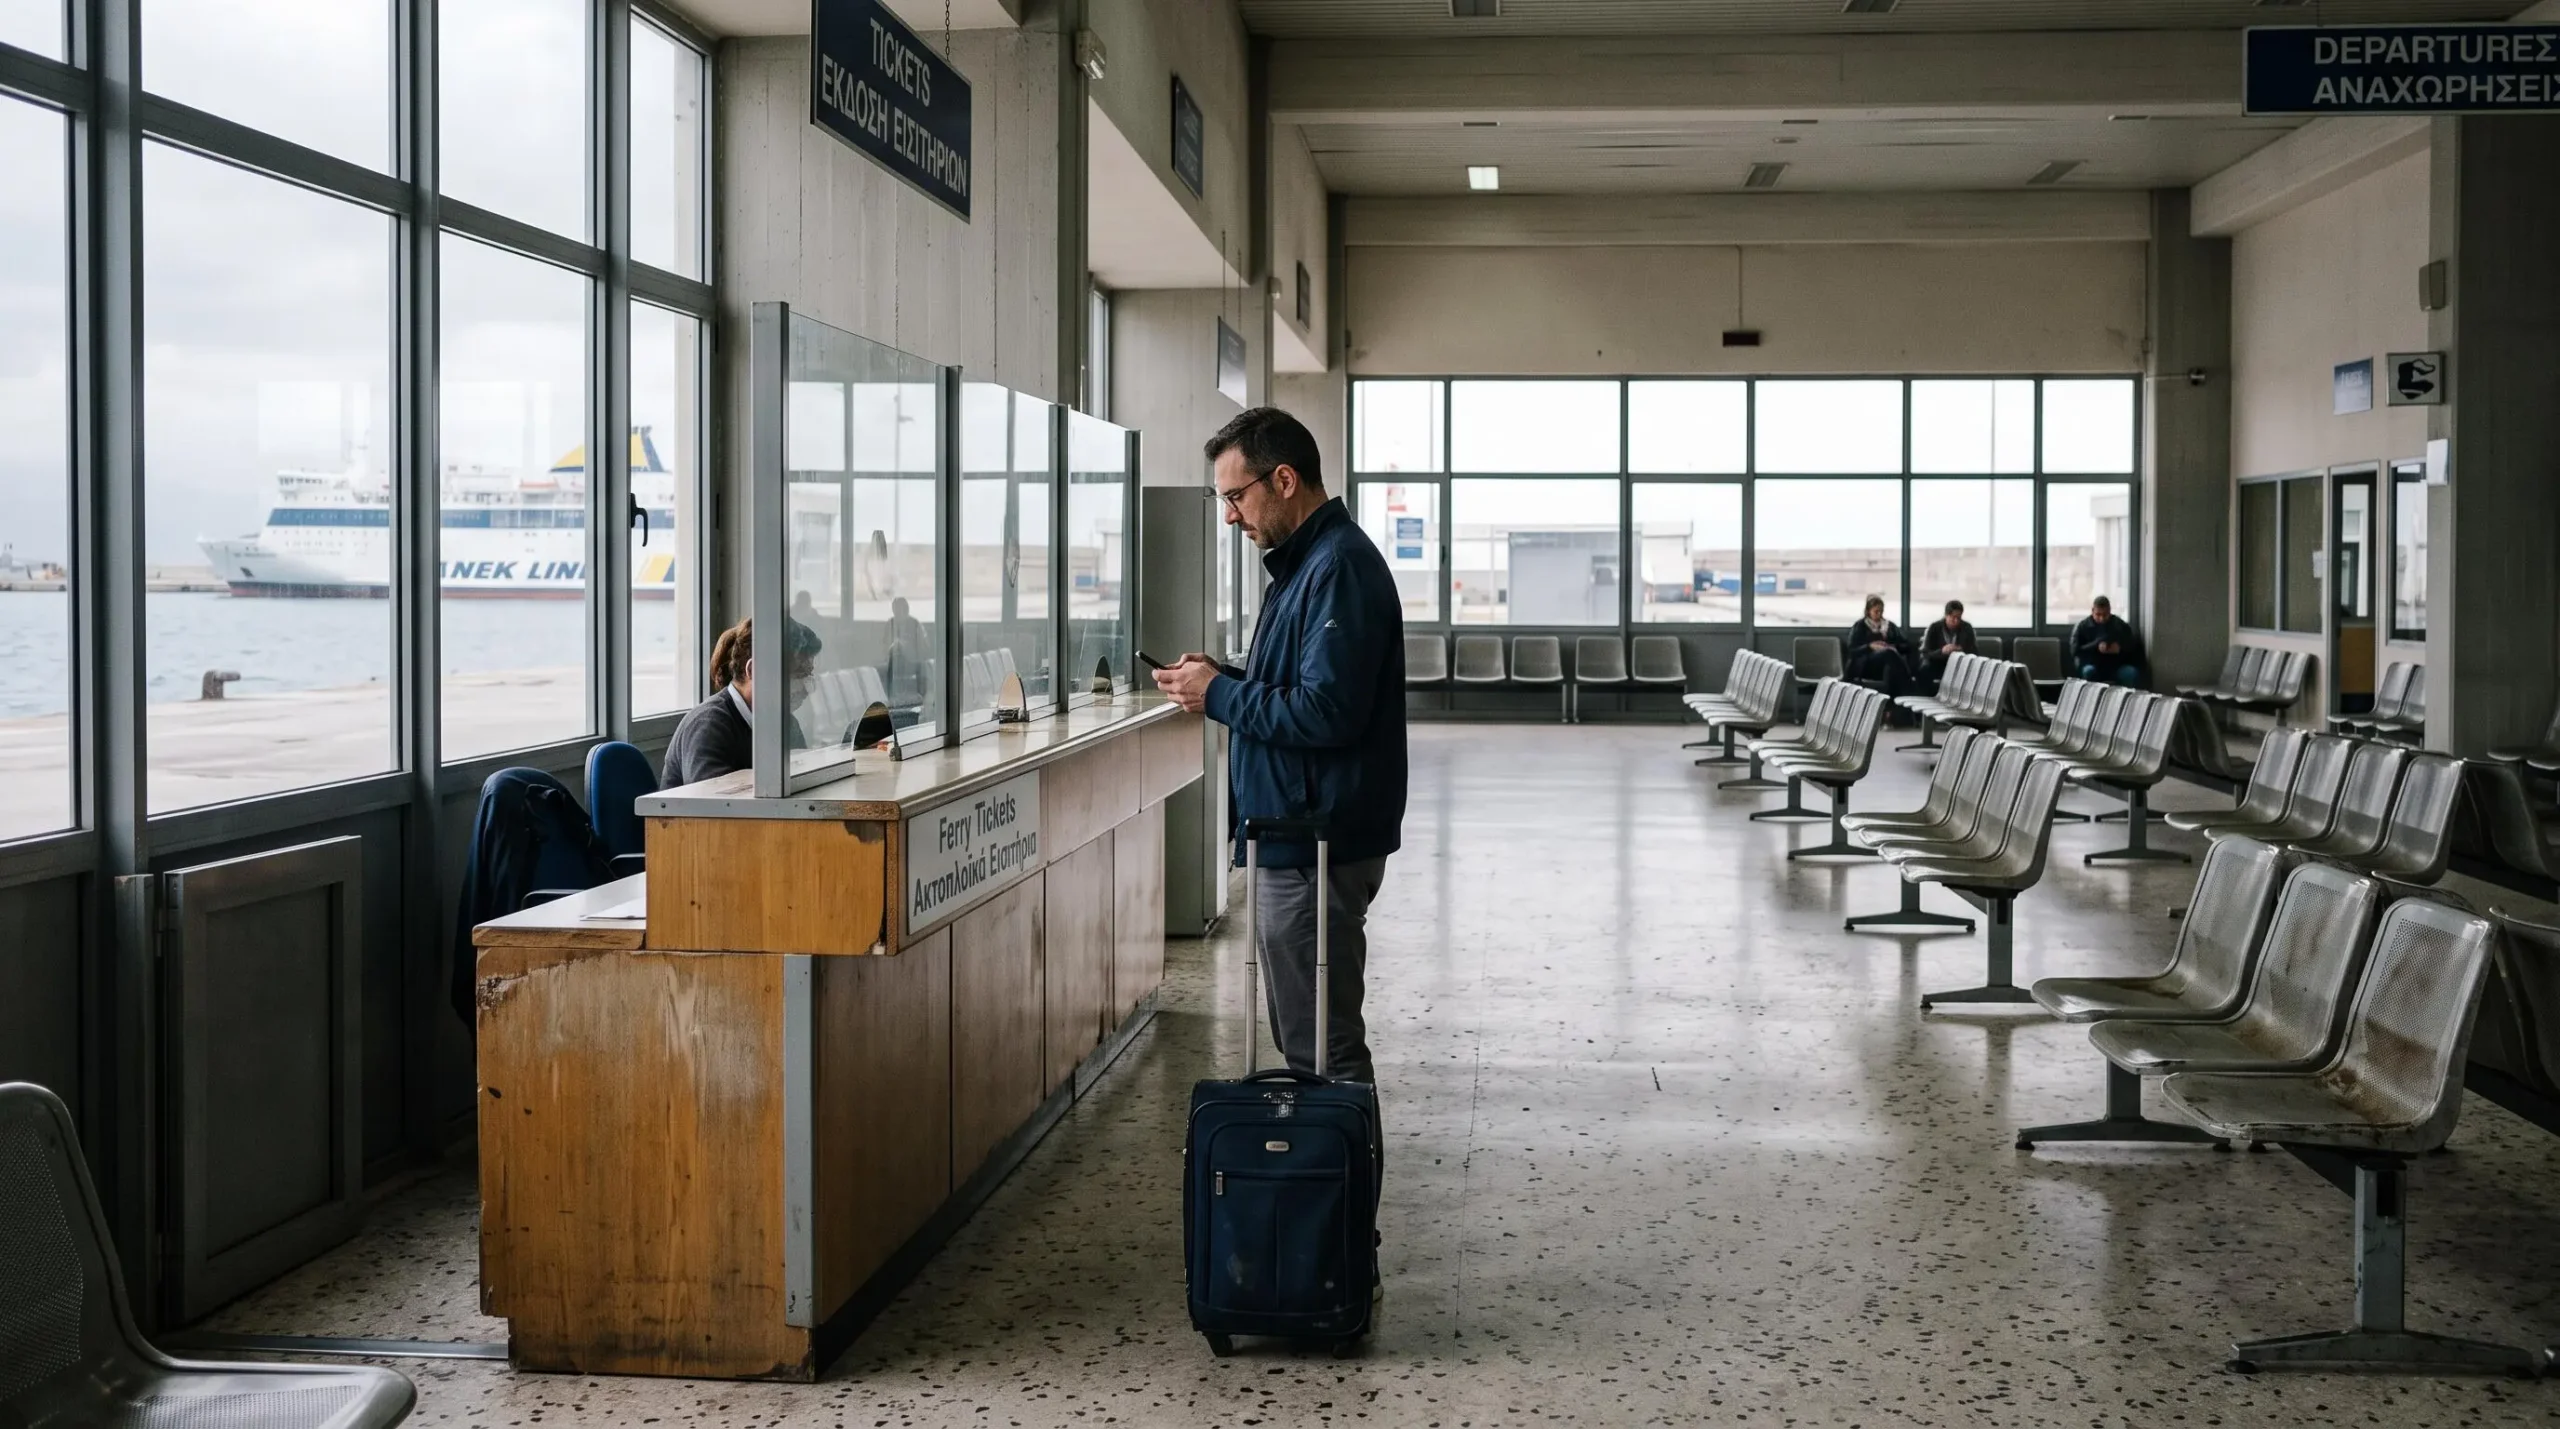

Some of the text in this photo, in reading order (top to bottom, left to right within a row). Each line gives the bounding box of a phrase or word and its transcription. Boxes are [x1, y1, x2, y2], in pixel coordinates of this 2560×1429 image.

[870, 17, 931, 107] TICKETS
[822, 53, 967, 197] ΕΚΔΟΣΗ ΕΙΣΙΤΗΡΙΩΝ
[939, 793, 1016, 854] Ferry Tickets
[913, 831, 1037, 917] Ακτοπλοϊκά Εισιτήρια
